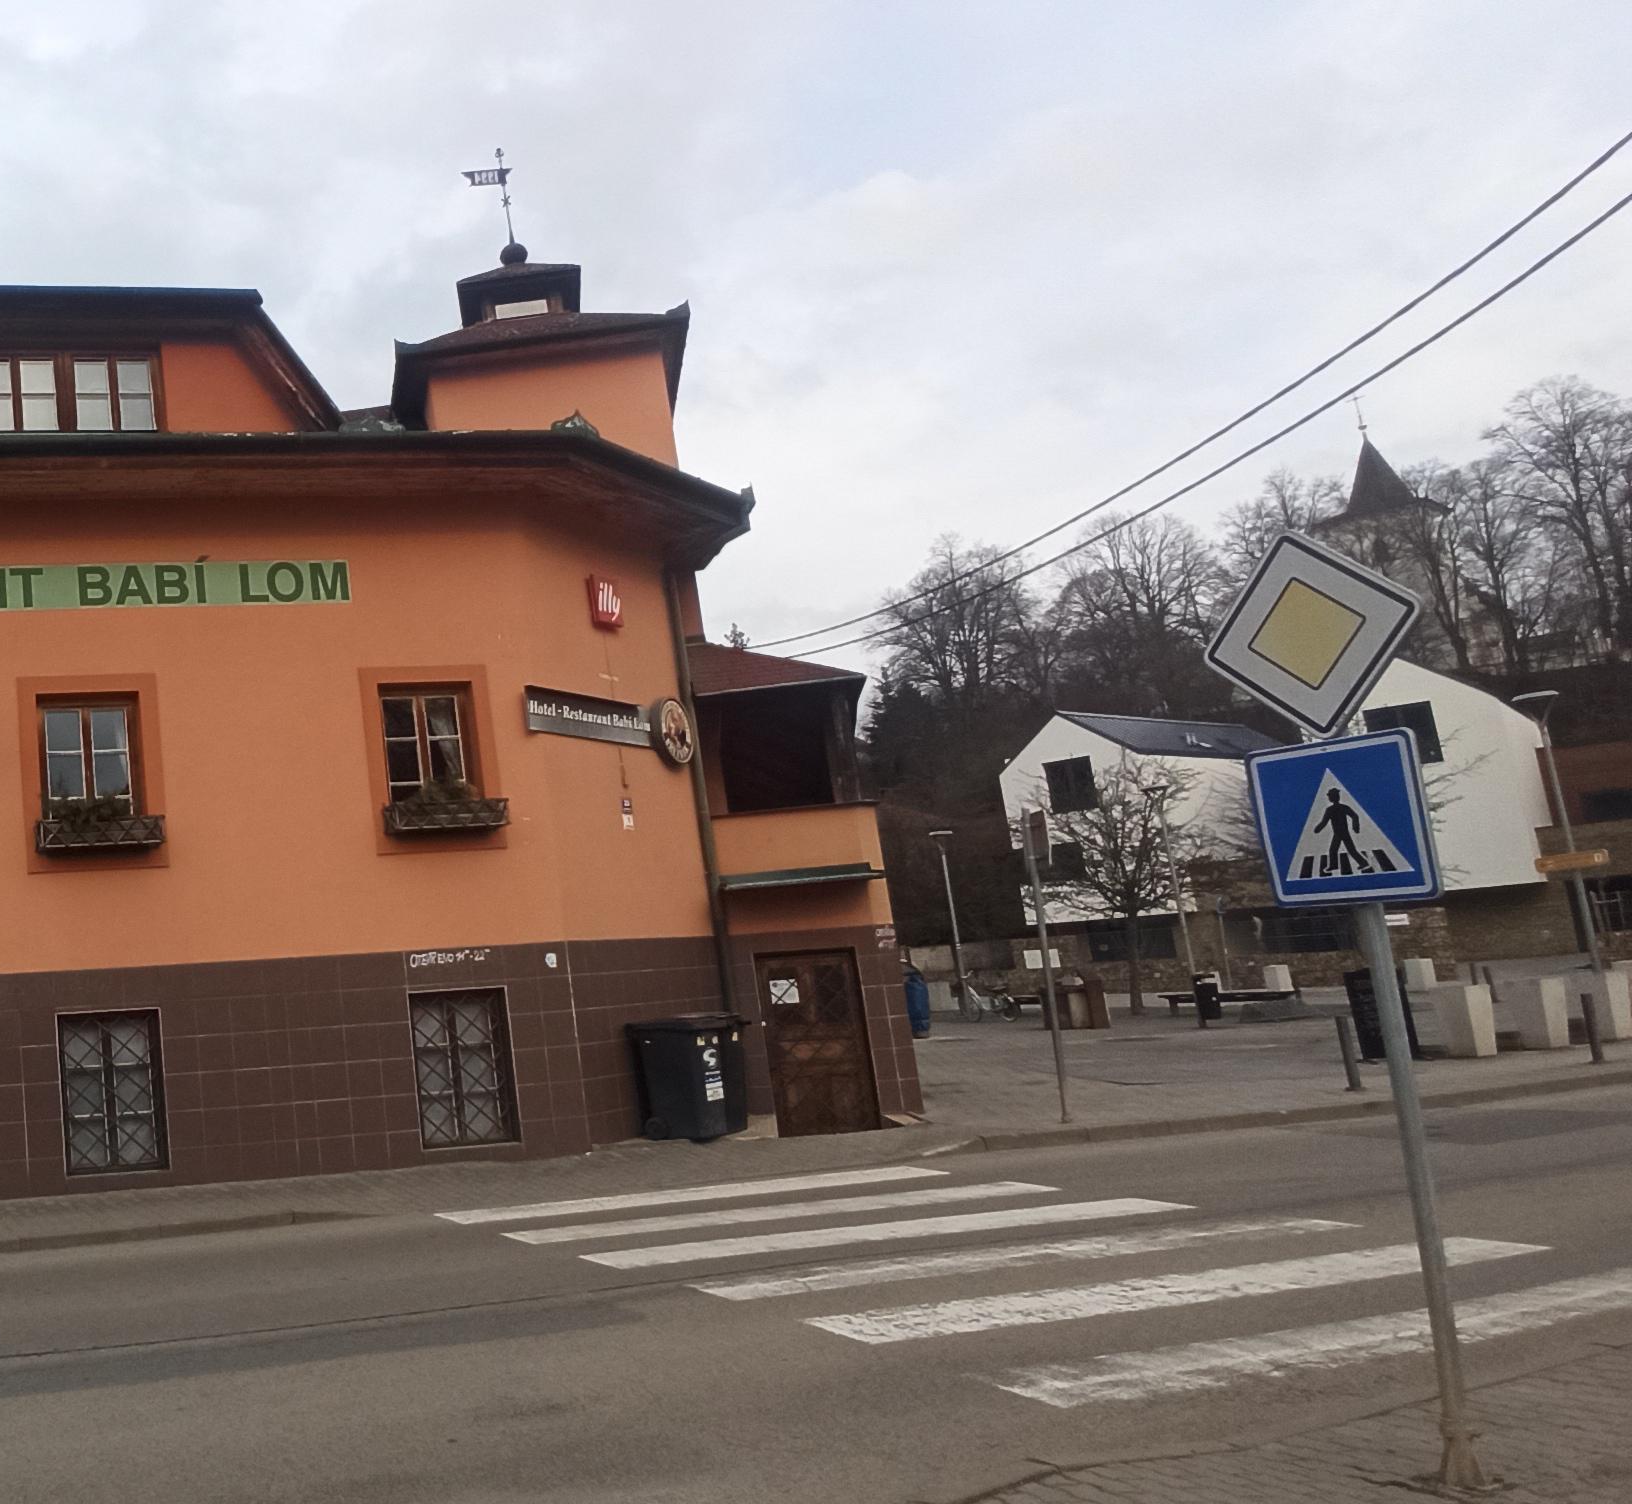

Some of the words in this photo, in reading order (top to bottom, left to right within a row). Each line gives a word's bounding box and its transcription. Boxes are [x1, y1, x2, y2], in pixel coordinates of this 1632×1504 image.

[77, 555, 209, 607] BABÍ
[239, 561, 351, 604] LOM
[598, 582, 621, 622] illy
[529, 699, 556, 717] Hotel
[563, 705, 612, 726] Restaurant
[633, 717, 652, 732] Lom
